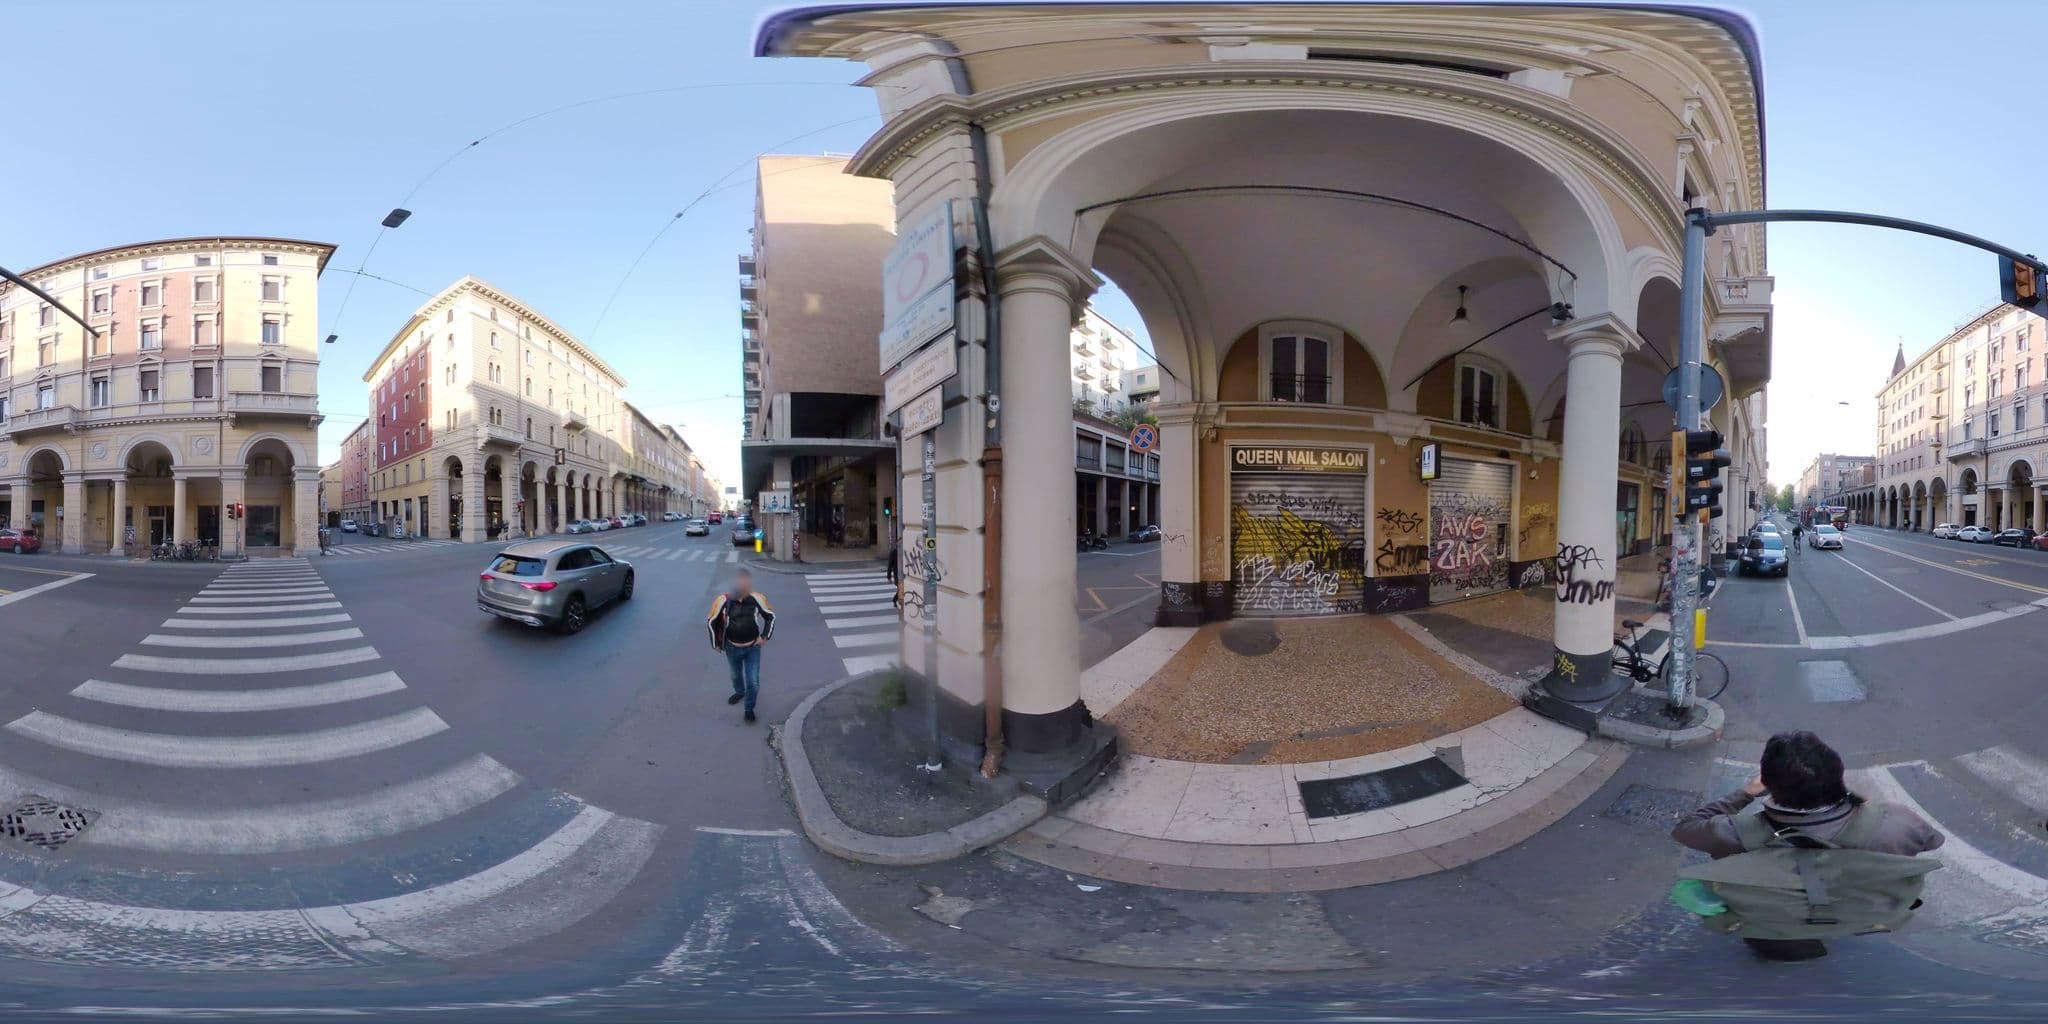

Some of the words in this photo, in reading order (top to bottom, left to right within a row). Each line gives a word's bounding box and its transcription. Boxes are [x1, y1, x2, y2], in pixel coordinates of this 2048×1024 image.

[1236, 450, 1283, 465] QUEEN
[1287, 450, 1318, 465] NAIL
[1321, 451, 1364, 467] SALON
[1439, 514, 1488, 540] AWS
